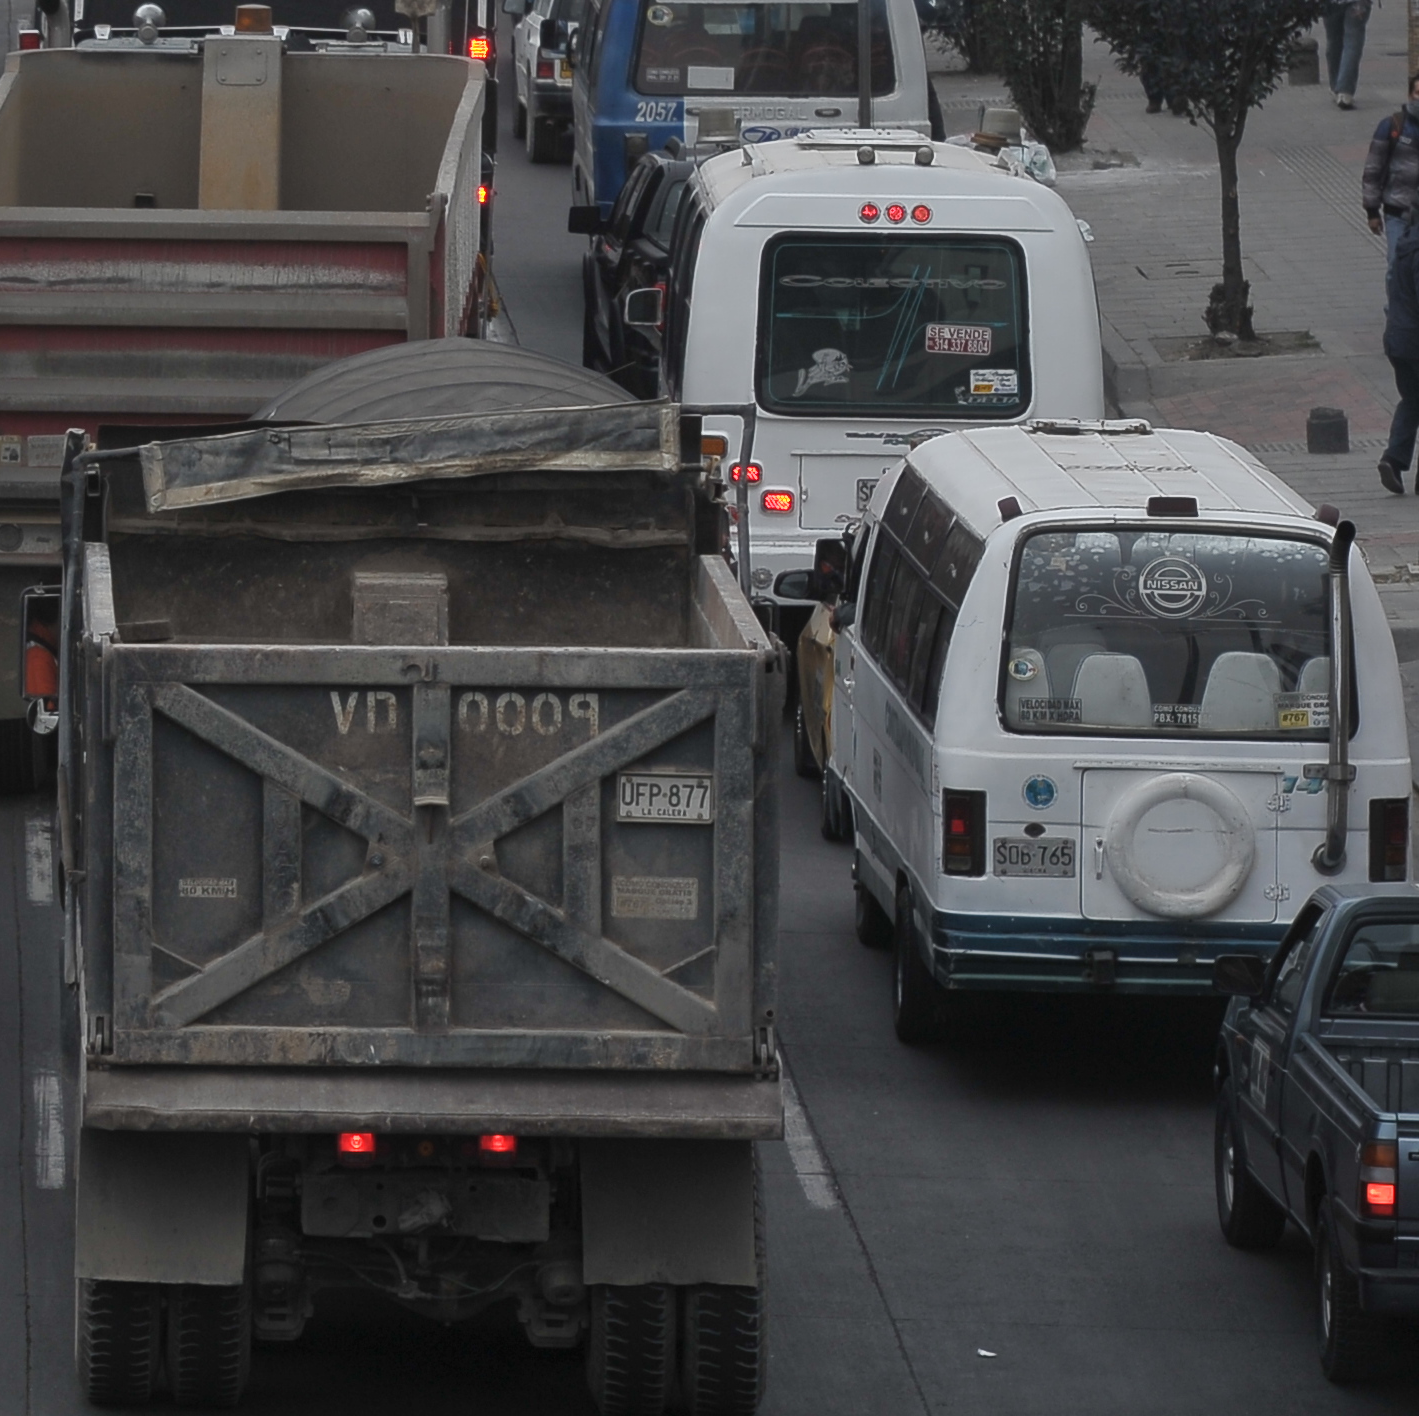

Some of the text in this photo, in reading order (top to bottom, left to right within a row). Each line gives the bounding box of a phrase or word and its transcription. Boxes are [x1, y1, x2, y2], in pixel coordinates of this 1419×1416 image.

[928, 327, 989, 341] SE VENDE
[1146, 579, 1199, 591] NISSAN
[1021, 699, 1080, 710] VELOCIDAD MAX
[1154, 713, 1175, 724] PBX:
[1282, 712, 1306, 722] #767
[641, 807, 687, 817] LA CALERA
